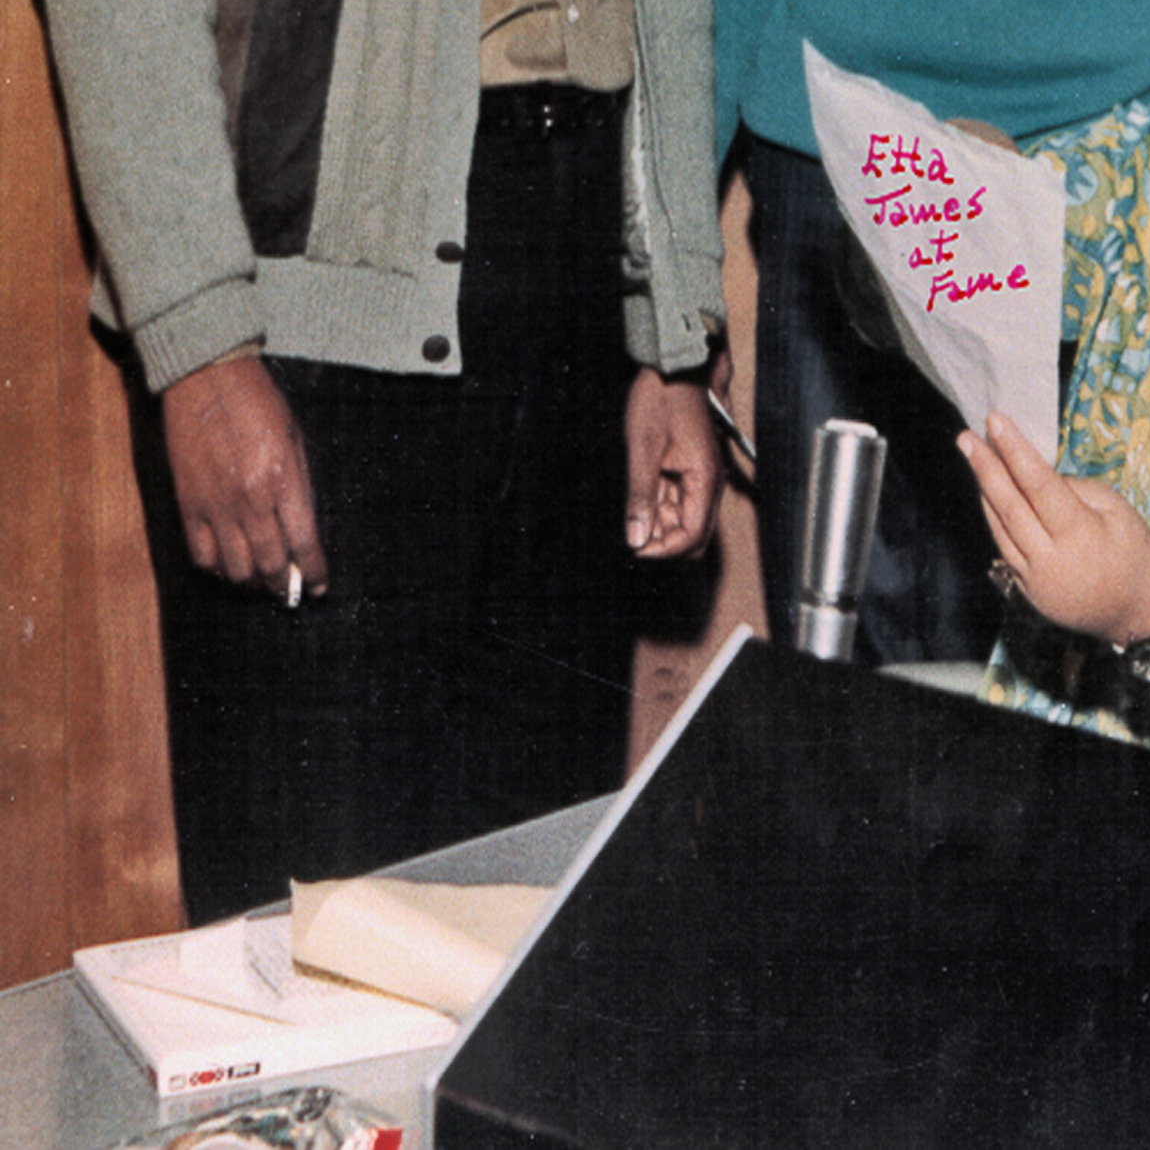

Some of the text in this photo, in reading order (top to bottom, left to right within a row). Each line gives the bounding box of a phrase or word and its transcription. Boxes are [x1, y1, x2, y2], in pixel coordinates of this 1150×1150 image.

[861, 133, 956, 185] Etta
[864, 184, 988, 227] James
[909, 229, 960, 269] at
[925, 264, 1031, 313] Fame
